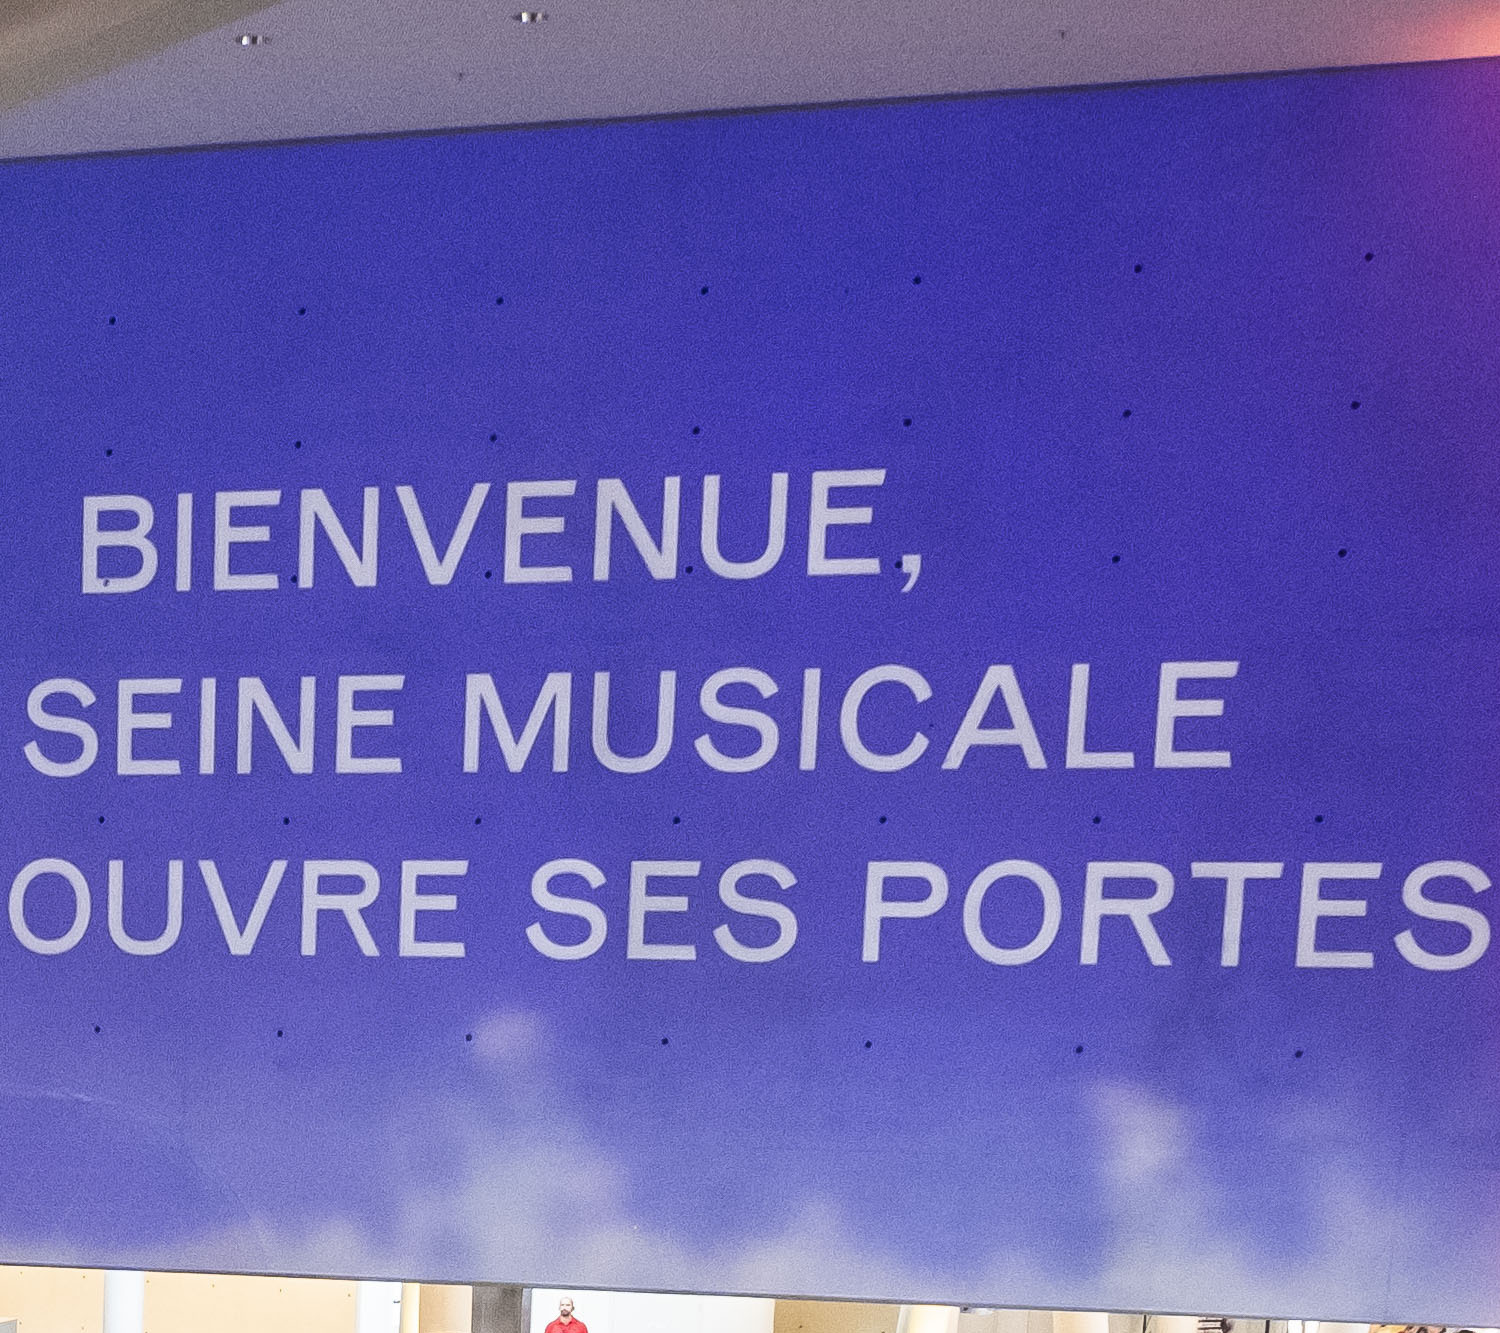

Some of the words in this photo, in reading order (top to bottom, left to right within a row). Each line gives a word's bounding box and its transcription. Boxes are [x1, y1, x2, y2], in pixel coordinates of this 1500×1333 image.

[81, 468, 922, 594] BIENVENUE,
[23, 674, 406, 778] SEINE
[463, 660, 1239, 774] MUSICALE
[8, 857, 469, 958] OUVRE
[525, 858, 798, 963] SES
[861, 860, 1492, 971] PORTES
